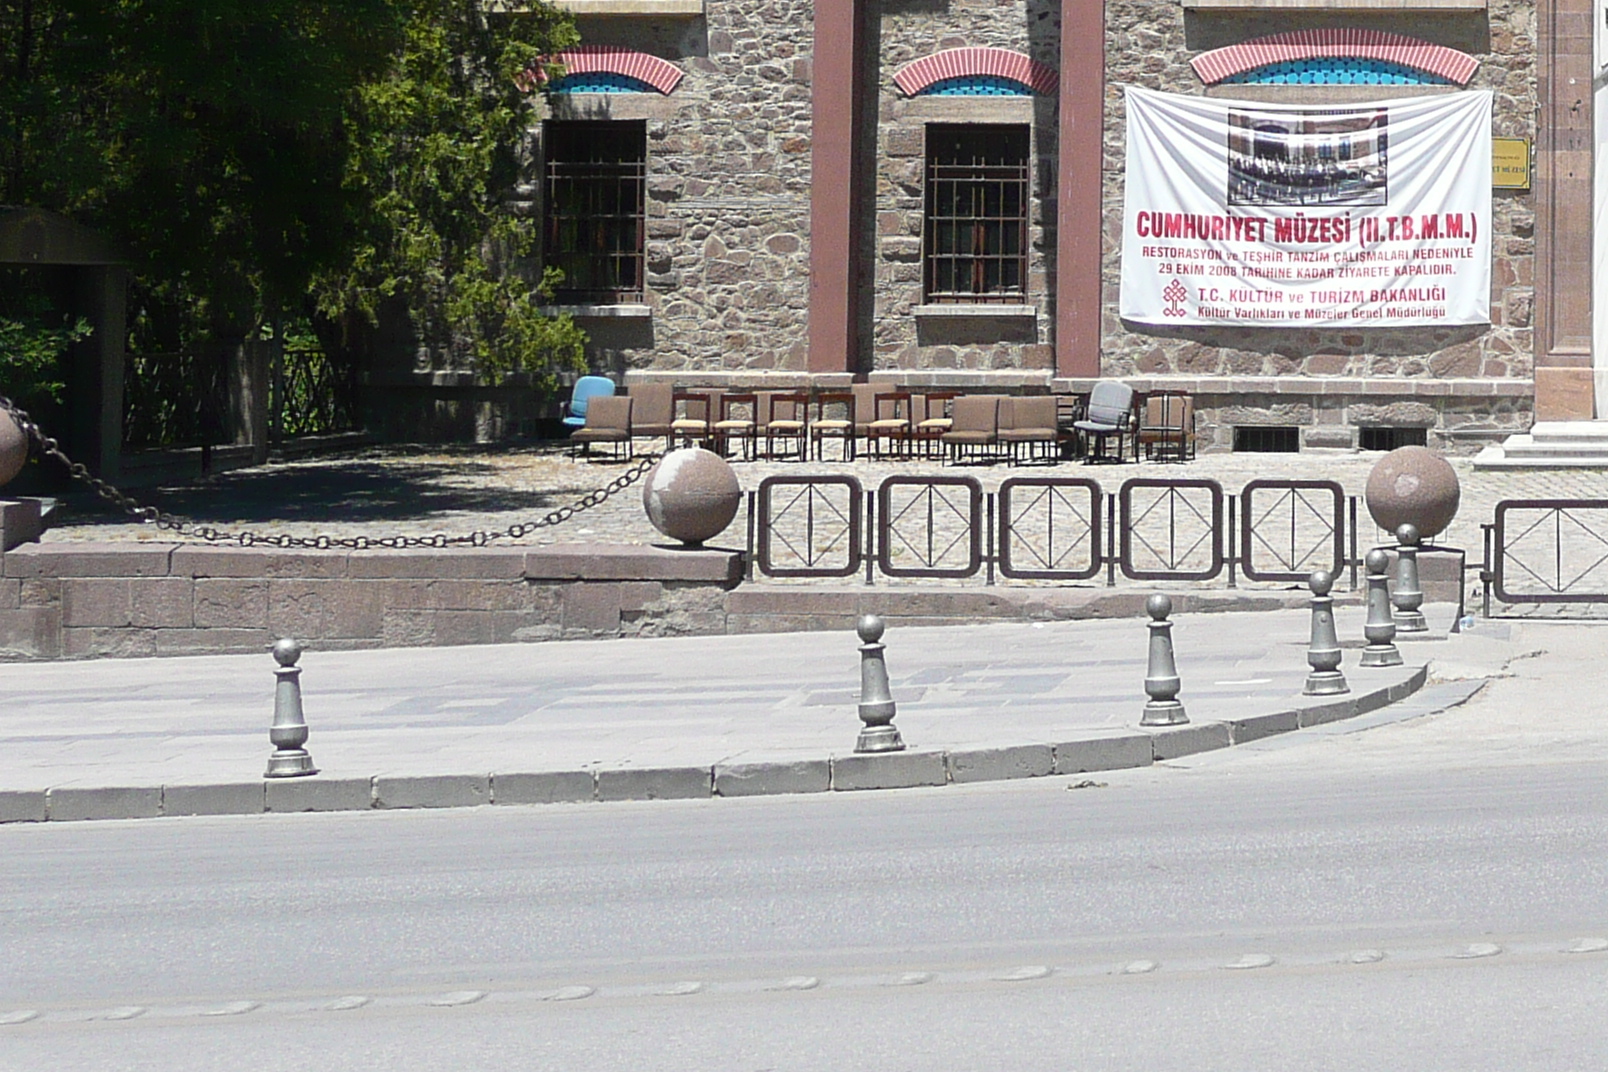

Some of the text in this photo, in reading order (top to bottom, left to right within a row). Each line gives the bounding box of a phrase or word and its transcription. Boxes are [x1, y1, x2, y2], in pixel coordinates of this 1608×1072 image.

[1137, 210, 1477, 249] CUMHURİYET MÜZESİ (II.T.B.M.M.)
[1142, 246, 1474, 265] RESTORASYON ve TEŞHİR TANZİM ÇALIŞMALARI NEDENİYLE
[1158, 263, 1173, 274] 29
[1176, 262, 1205, 275] EKİM
[1208, 265, 1237, 277] 2008
[1296, 266, 1335, 279] KADAR
[1338, 264, 1391, 278] ZİYARETE
[1394, 263, 1457, 277] KAPALIDIR.
[1197, 284, 1446, 304] T.C. KÜLTÜR ve TURİZM BAKANLIĞI
[1197, 306, 1446, 320] Kültür Varlıkları ve Müzeler Genel Müdürlüğü
